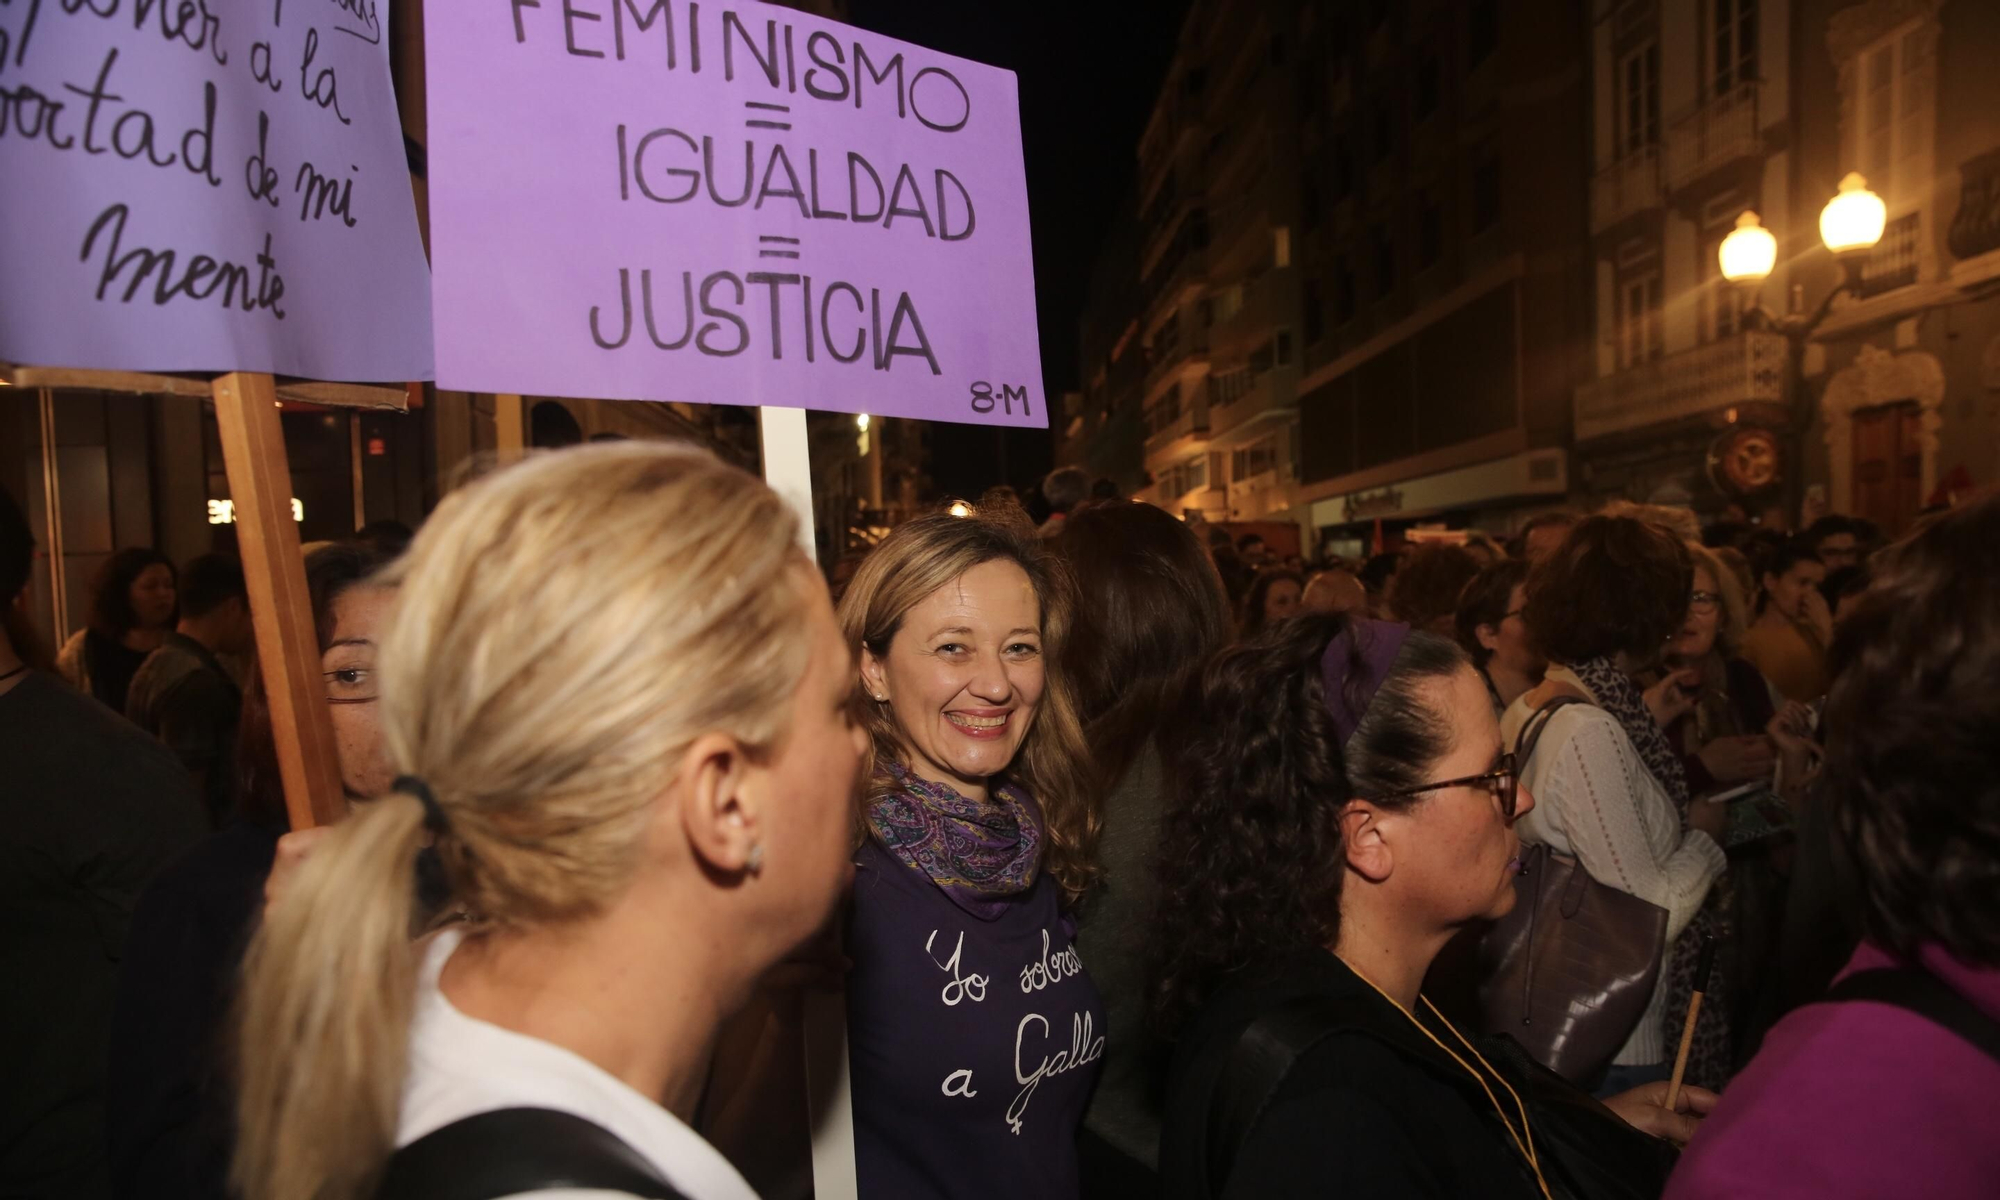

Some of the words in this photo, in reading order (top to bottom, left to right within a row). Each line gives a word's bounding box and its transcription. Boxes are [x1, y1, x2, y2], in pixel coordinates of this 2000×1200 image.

[250, 40, 282, 92] a
[301, 27, 352, 126] la
[507, 0, 971, 133] FEMINISMO
[246, 110, 280, 207] de
[295, 162, 357, 228] mi
[617, 124, 976, 241] IGUALDAD
[590, 268, 942, 376] JUSTICIA
[970, 381, 1030, 416] 8-M
[925, 929, 990, 1006] Yo
[941, 1069, 978, 1098] a
